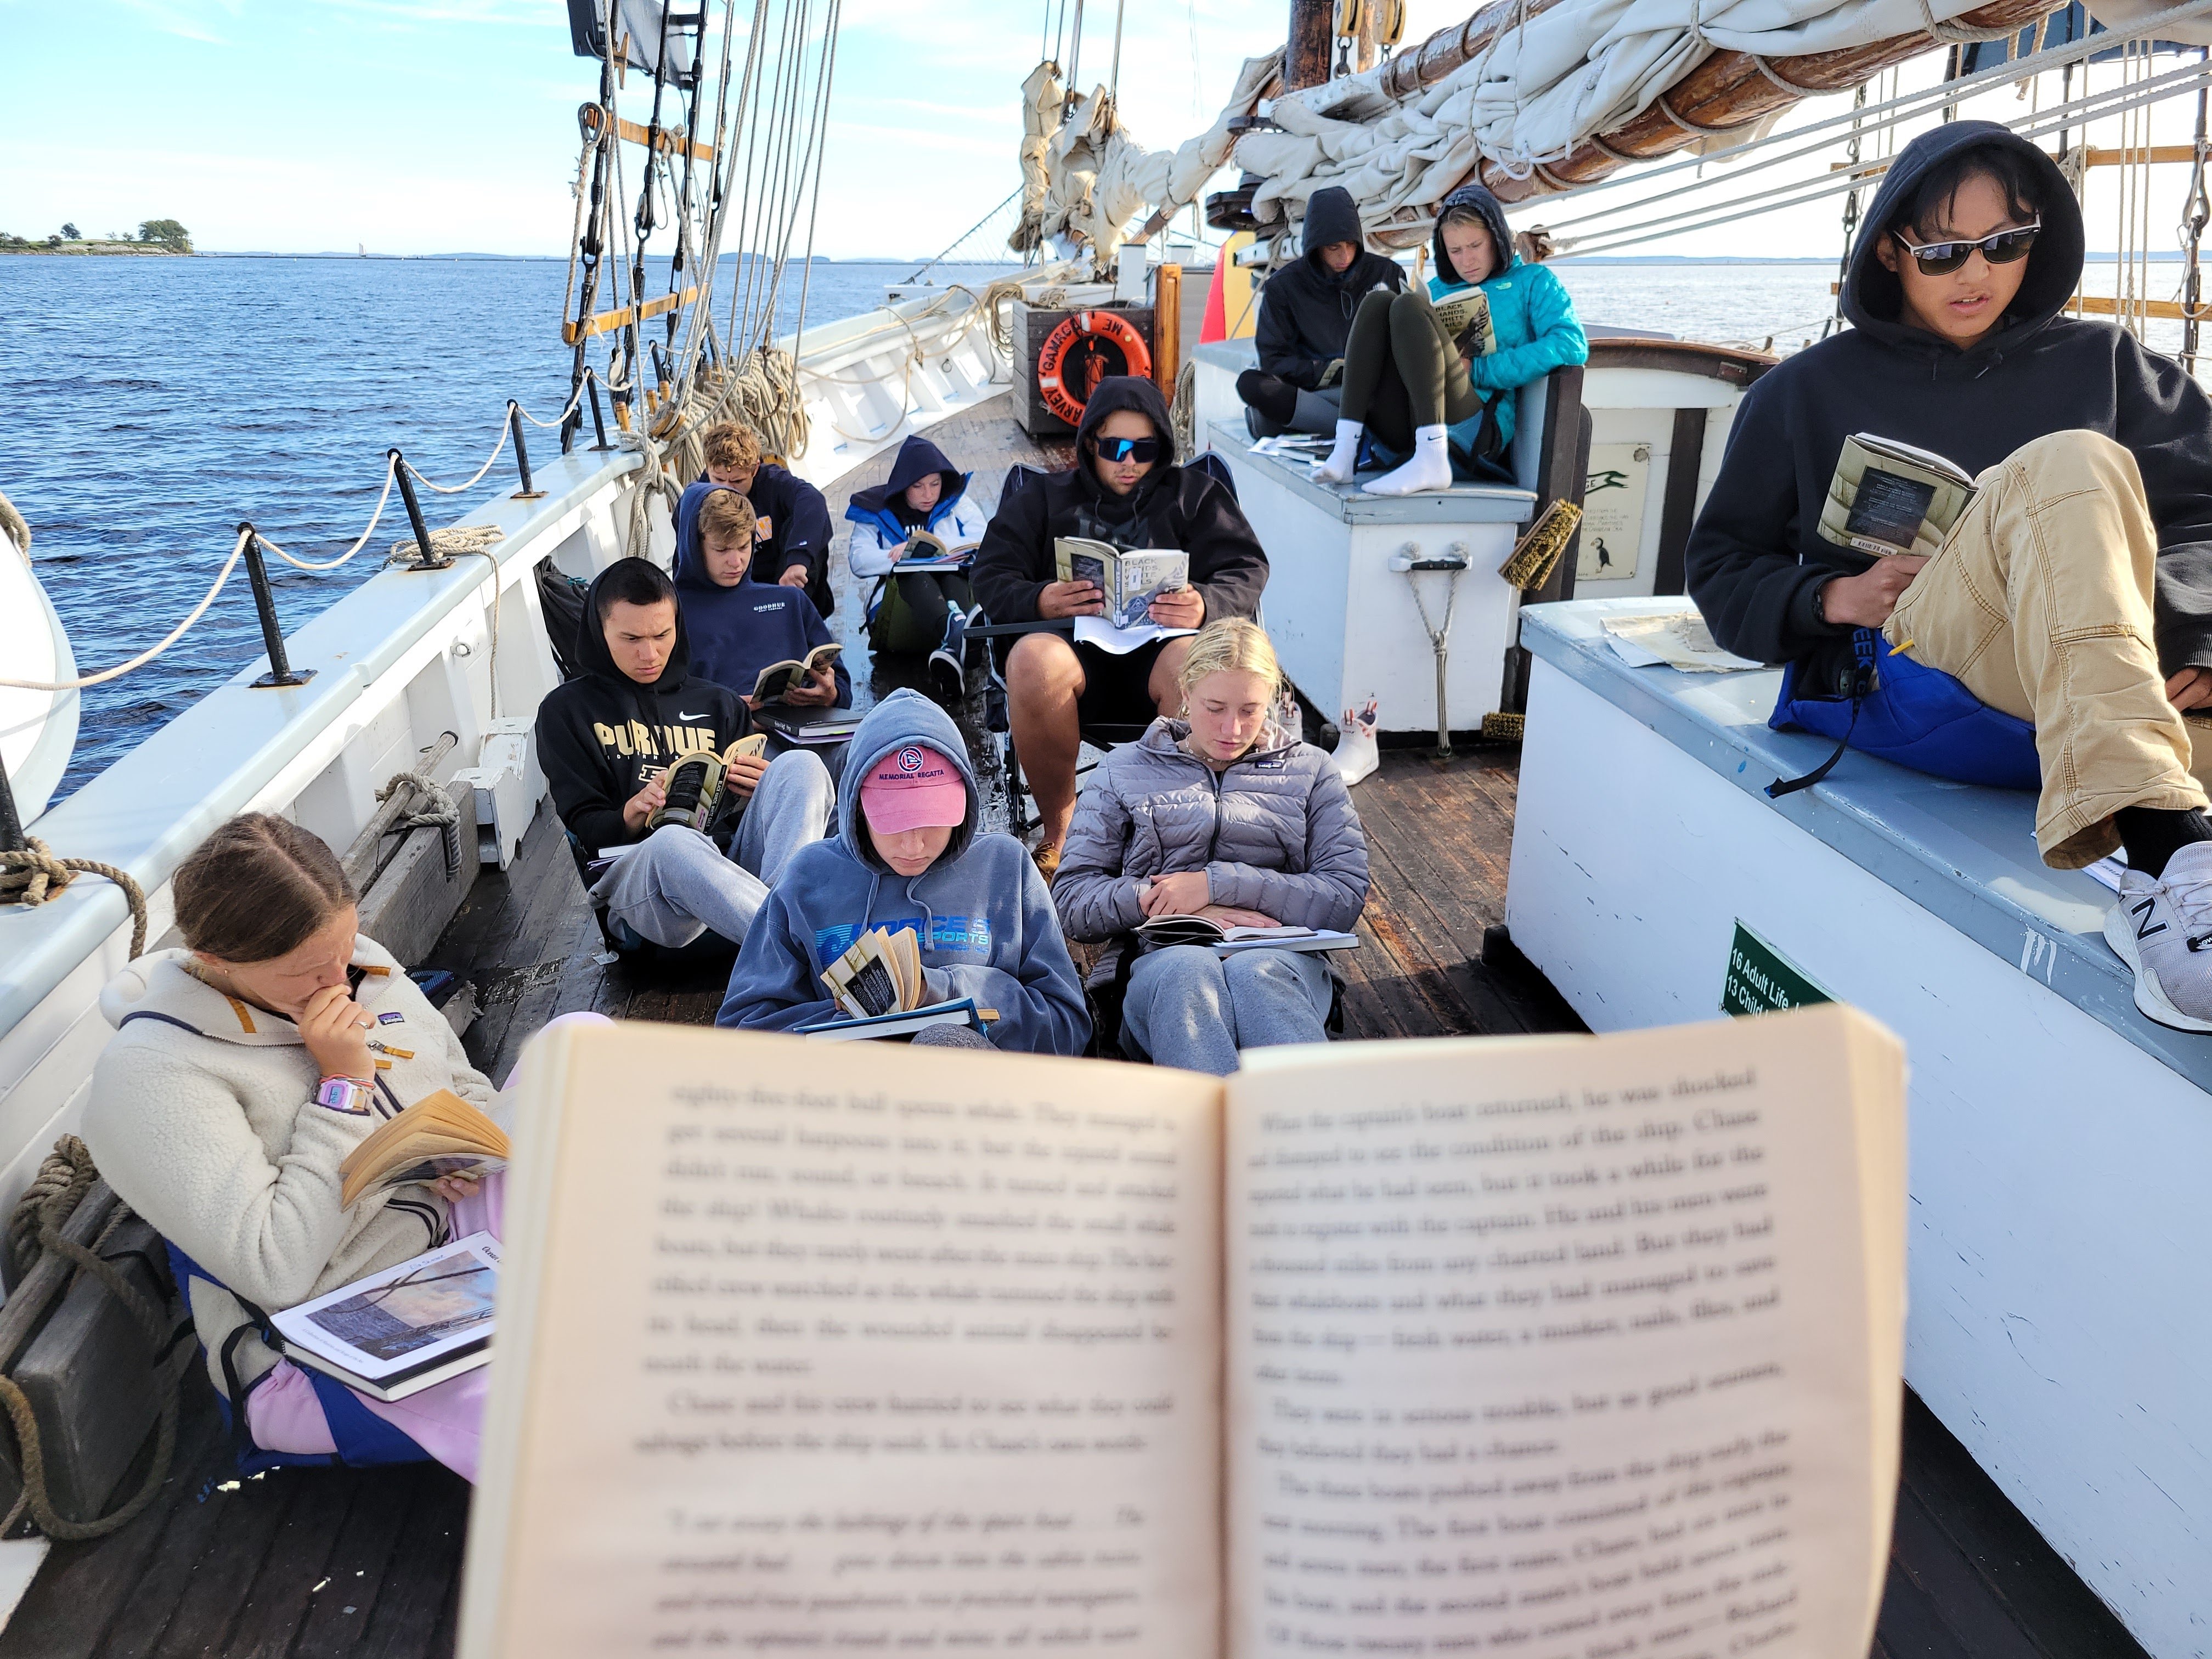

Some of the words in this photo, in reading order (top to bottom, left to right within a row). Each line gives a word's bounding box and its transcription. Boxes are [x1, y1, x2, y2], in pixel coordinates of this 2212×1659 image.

[1435, 303, 1463, 312] BLACK
[1102, 318, 1124, 336] ME
[1046, 389, 1083, 422] ARVEY
[917, 769, 944, 778] REGATTA
[1728, 975, 1738, 997] 13
[1733, 948, 1743, 970] 16
[1742, 959, 1769, 995] Adult
[1769, 981, 1788, 1012] Life
